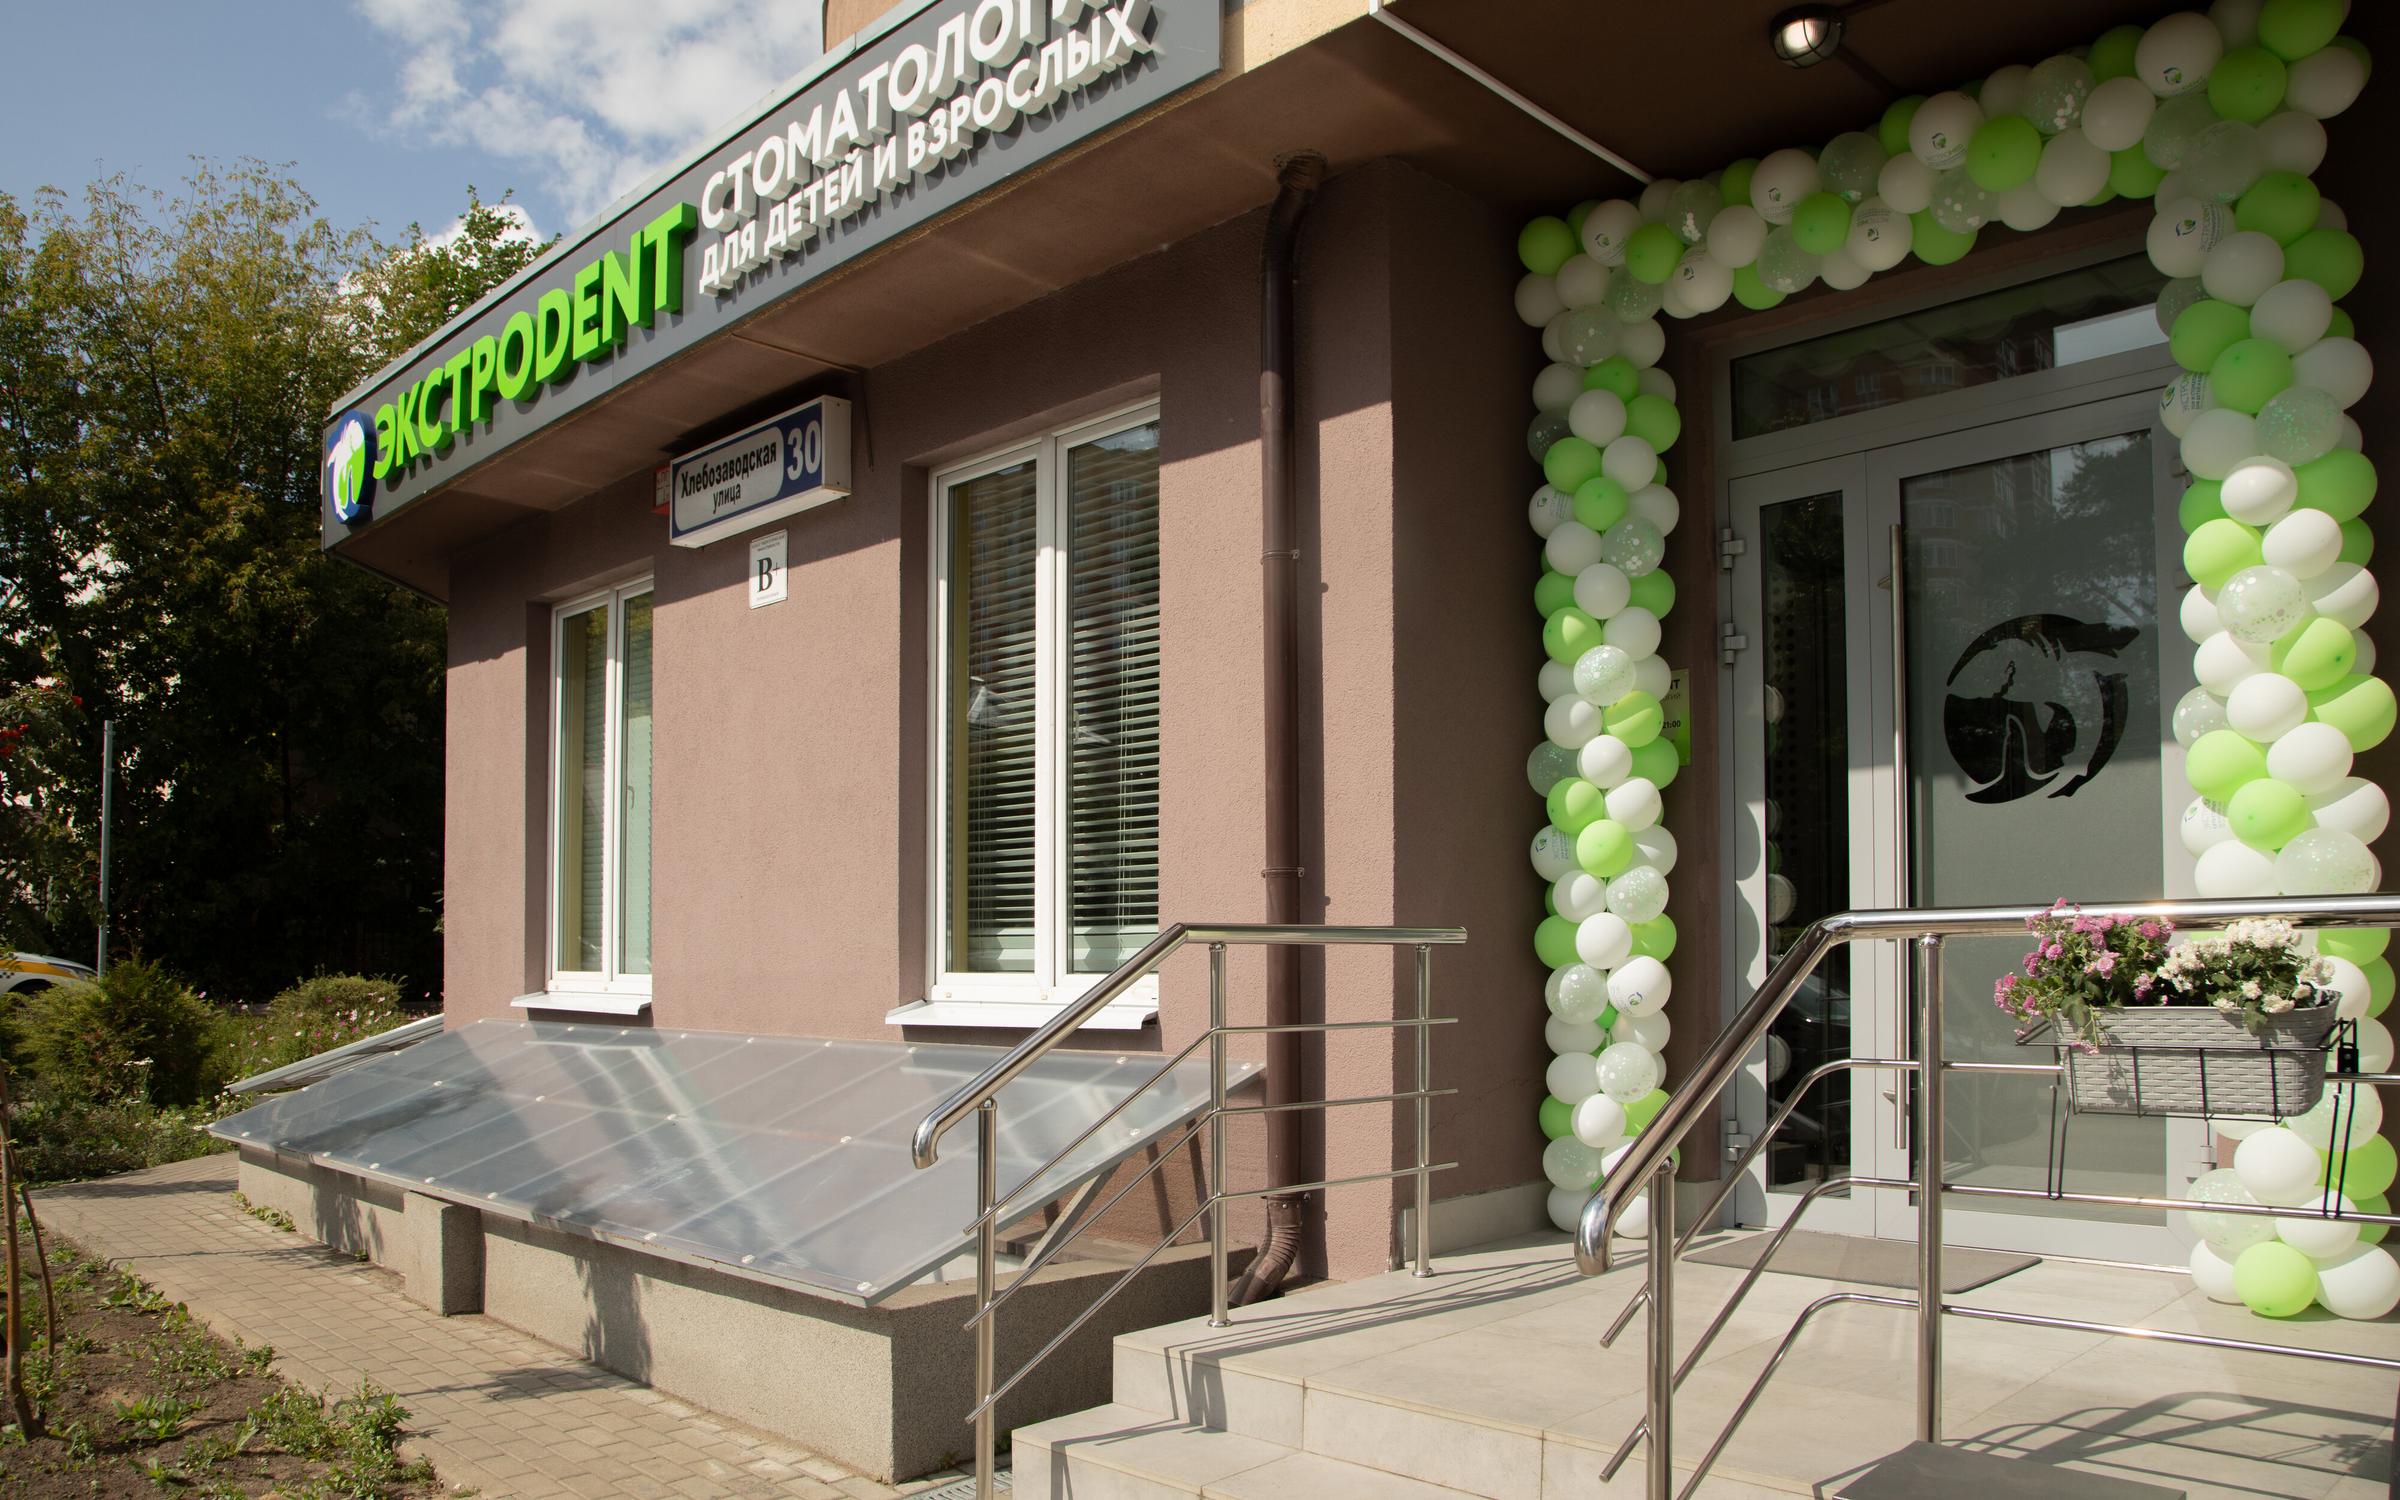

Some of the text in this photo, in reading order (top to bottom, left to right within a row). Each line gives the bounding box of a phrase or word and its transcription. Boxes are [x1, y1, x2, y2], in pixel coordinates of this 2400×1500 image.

[699, 0, 1138, 294] ДЛЯ ДЕТЕЙ И ВЗРОСЛЫХ
[702, 0, 1066, 229] СТОМАТОЛО
[372, 201, 692, 481] ЭКСТРОDENT
[680, 441, 777, 498] Хлебозаводская
[712, 483, 741, 514] улица
[786, 420, 822, 481] 30
